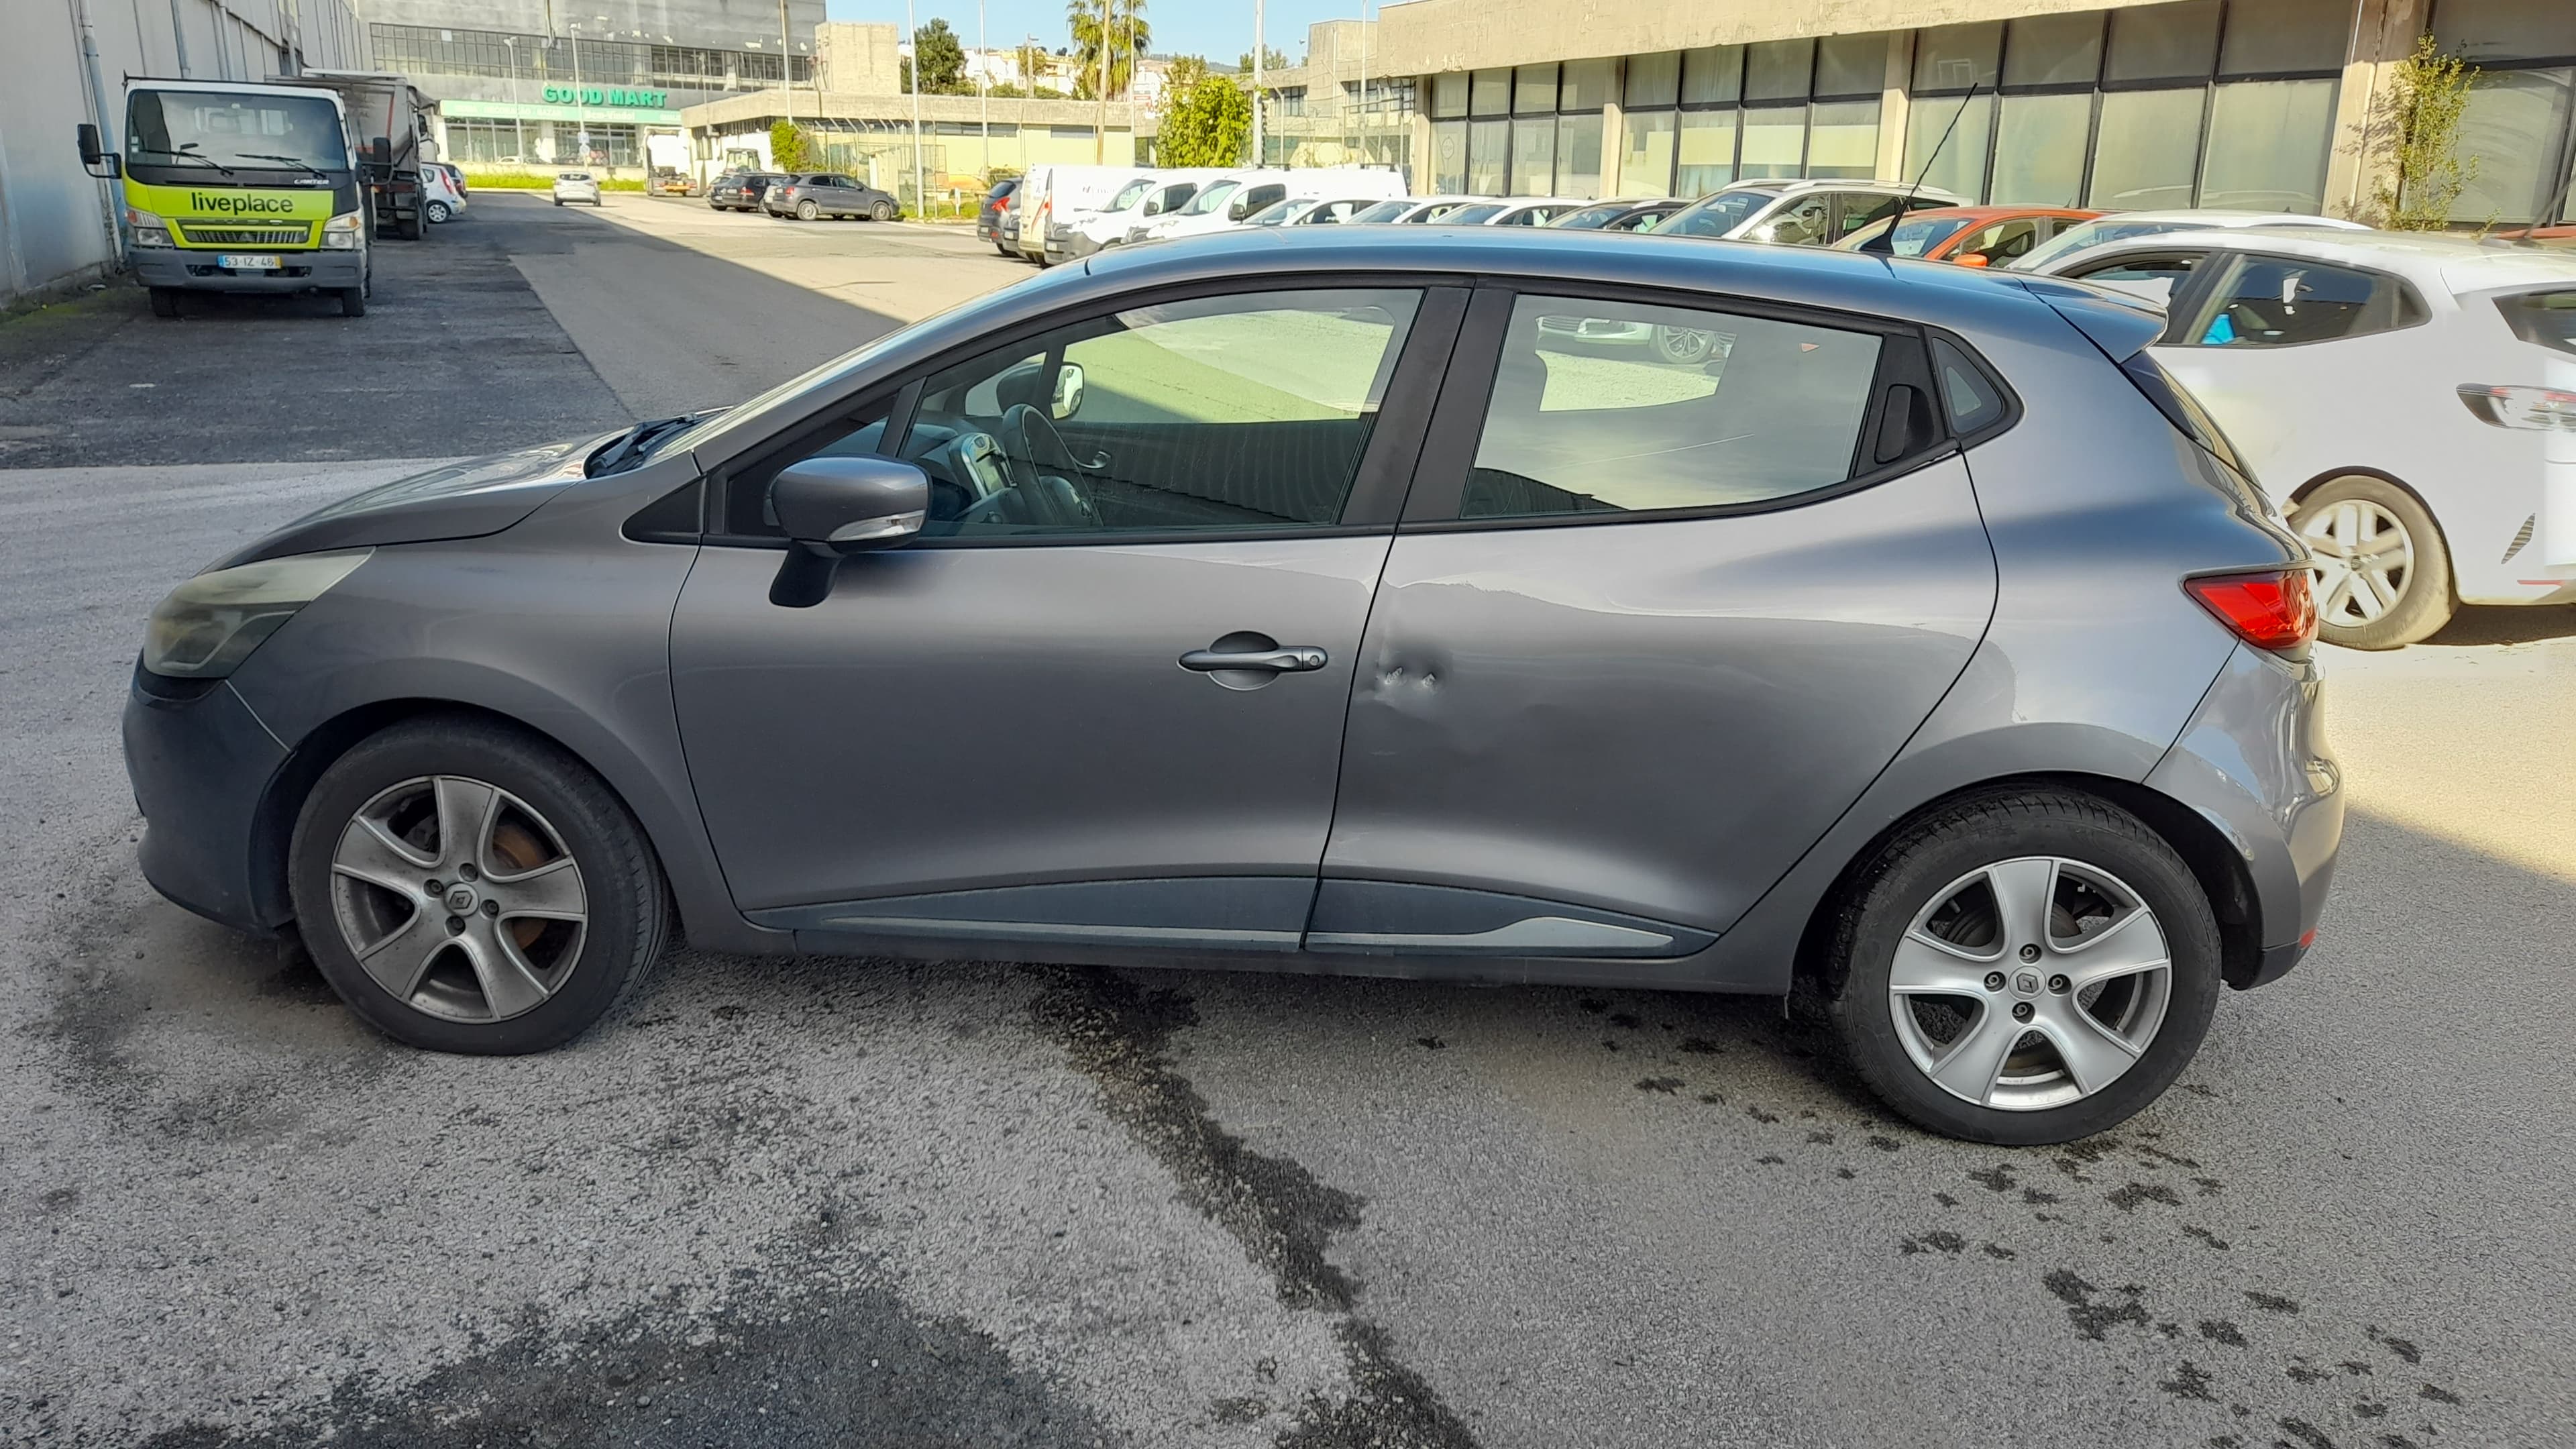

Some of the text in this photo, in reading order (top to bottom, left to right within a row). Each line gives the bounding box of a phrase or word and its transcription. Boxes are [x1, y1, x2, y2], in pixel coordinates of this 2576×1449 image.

[542, 85, 667, 108] GOOD MART
[191, 192, 294, 215] liveplace
